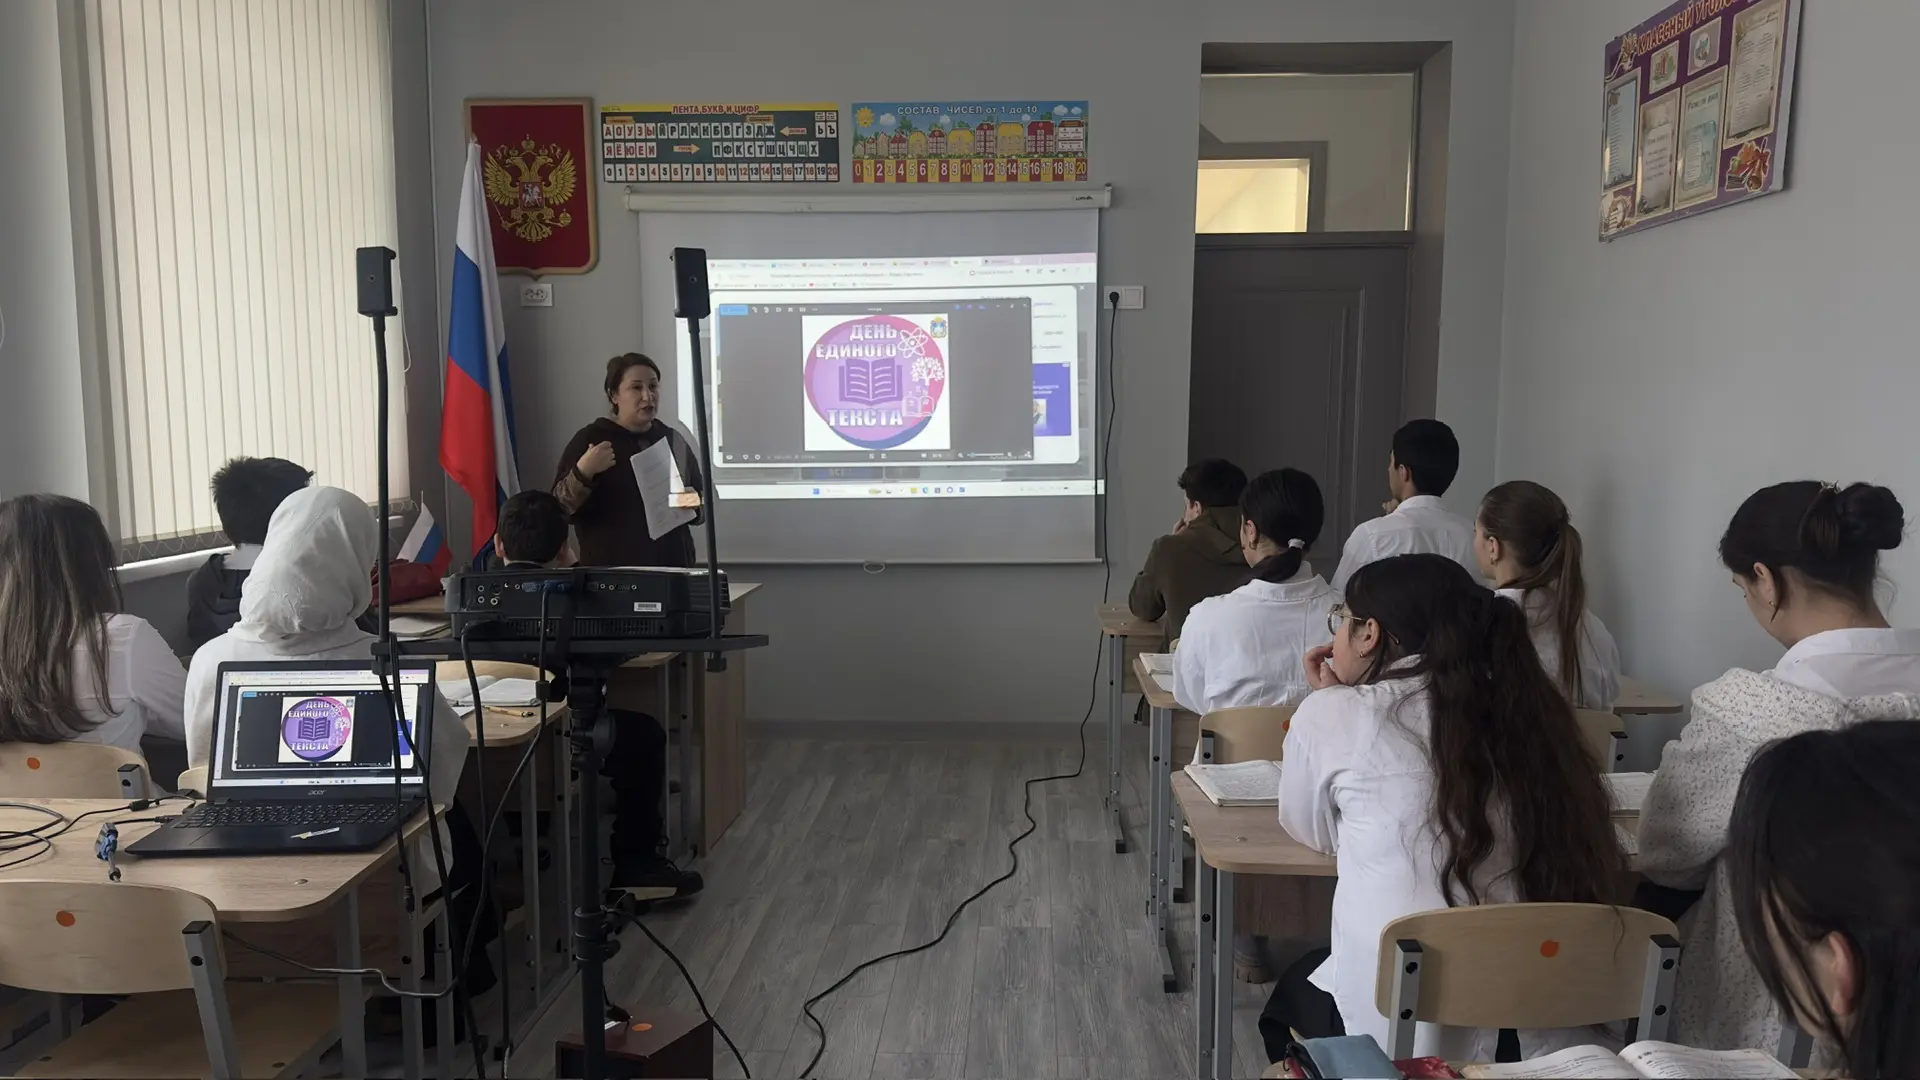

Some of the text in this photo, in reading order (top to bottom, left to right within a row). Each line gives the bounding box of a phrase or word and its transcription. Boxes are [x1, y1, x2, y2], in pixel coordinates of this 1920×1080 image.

[1638, 1, 1694, 56] КЛАССНЫЙ
[672, 104, 759, 114] ЛЕНТА БУКВ И ЦИФР
[897, 106, 940, 115] СОСТАВ
[947, 106, 983, 114] ЧИСЕЛ
[1009, 107, 1023, 115] до
[716, 168, 724, 176] 10
[729, 168, 736, 176] 11
[739, 168, 748, 176] 12
[750, 168, 759, 176] 13
[761, 167, 771, 176] 14
[772, 167, 781, 176] 15
[783, 167, 792, 176] 16
[794, 167, 803, 176] 17
[805, 167, 814, 176] 18
[817, 167, 826, 176] 19
[827, 167, 838, 176] 20
[855, 163, 1087, 175] 0 1 2 3 4 5 6 7 8 9 10 11 12 13 14 15 16 17 18 19 20
[850, 324, 897, 341] ДЕНЬ
[816, 343, 897, 359] ЕДИНОГО
[827, 408, 903, 426] ТЕКСТА
[306, 701, 330, 709] ДЕНЬ
[288, 710, 329, 718] ЕДИНОГО
[291, 742, 329, 751] ТЕКСТА
